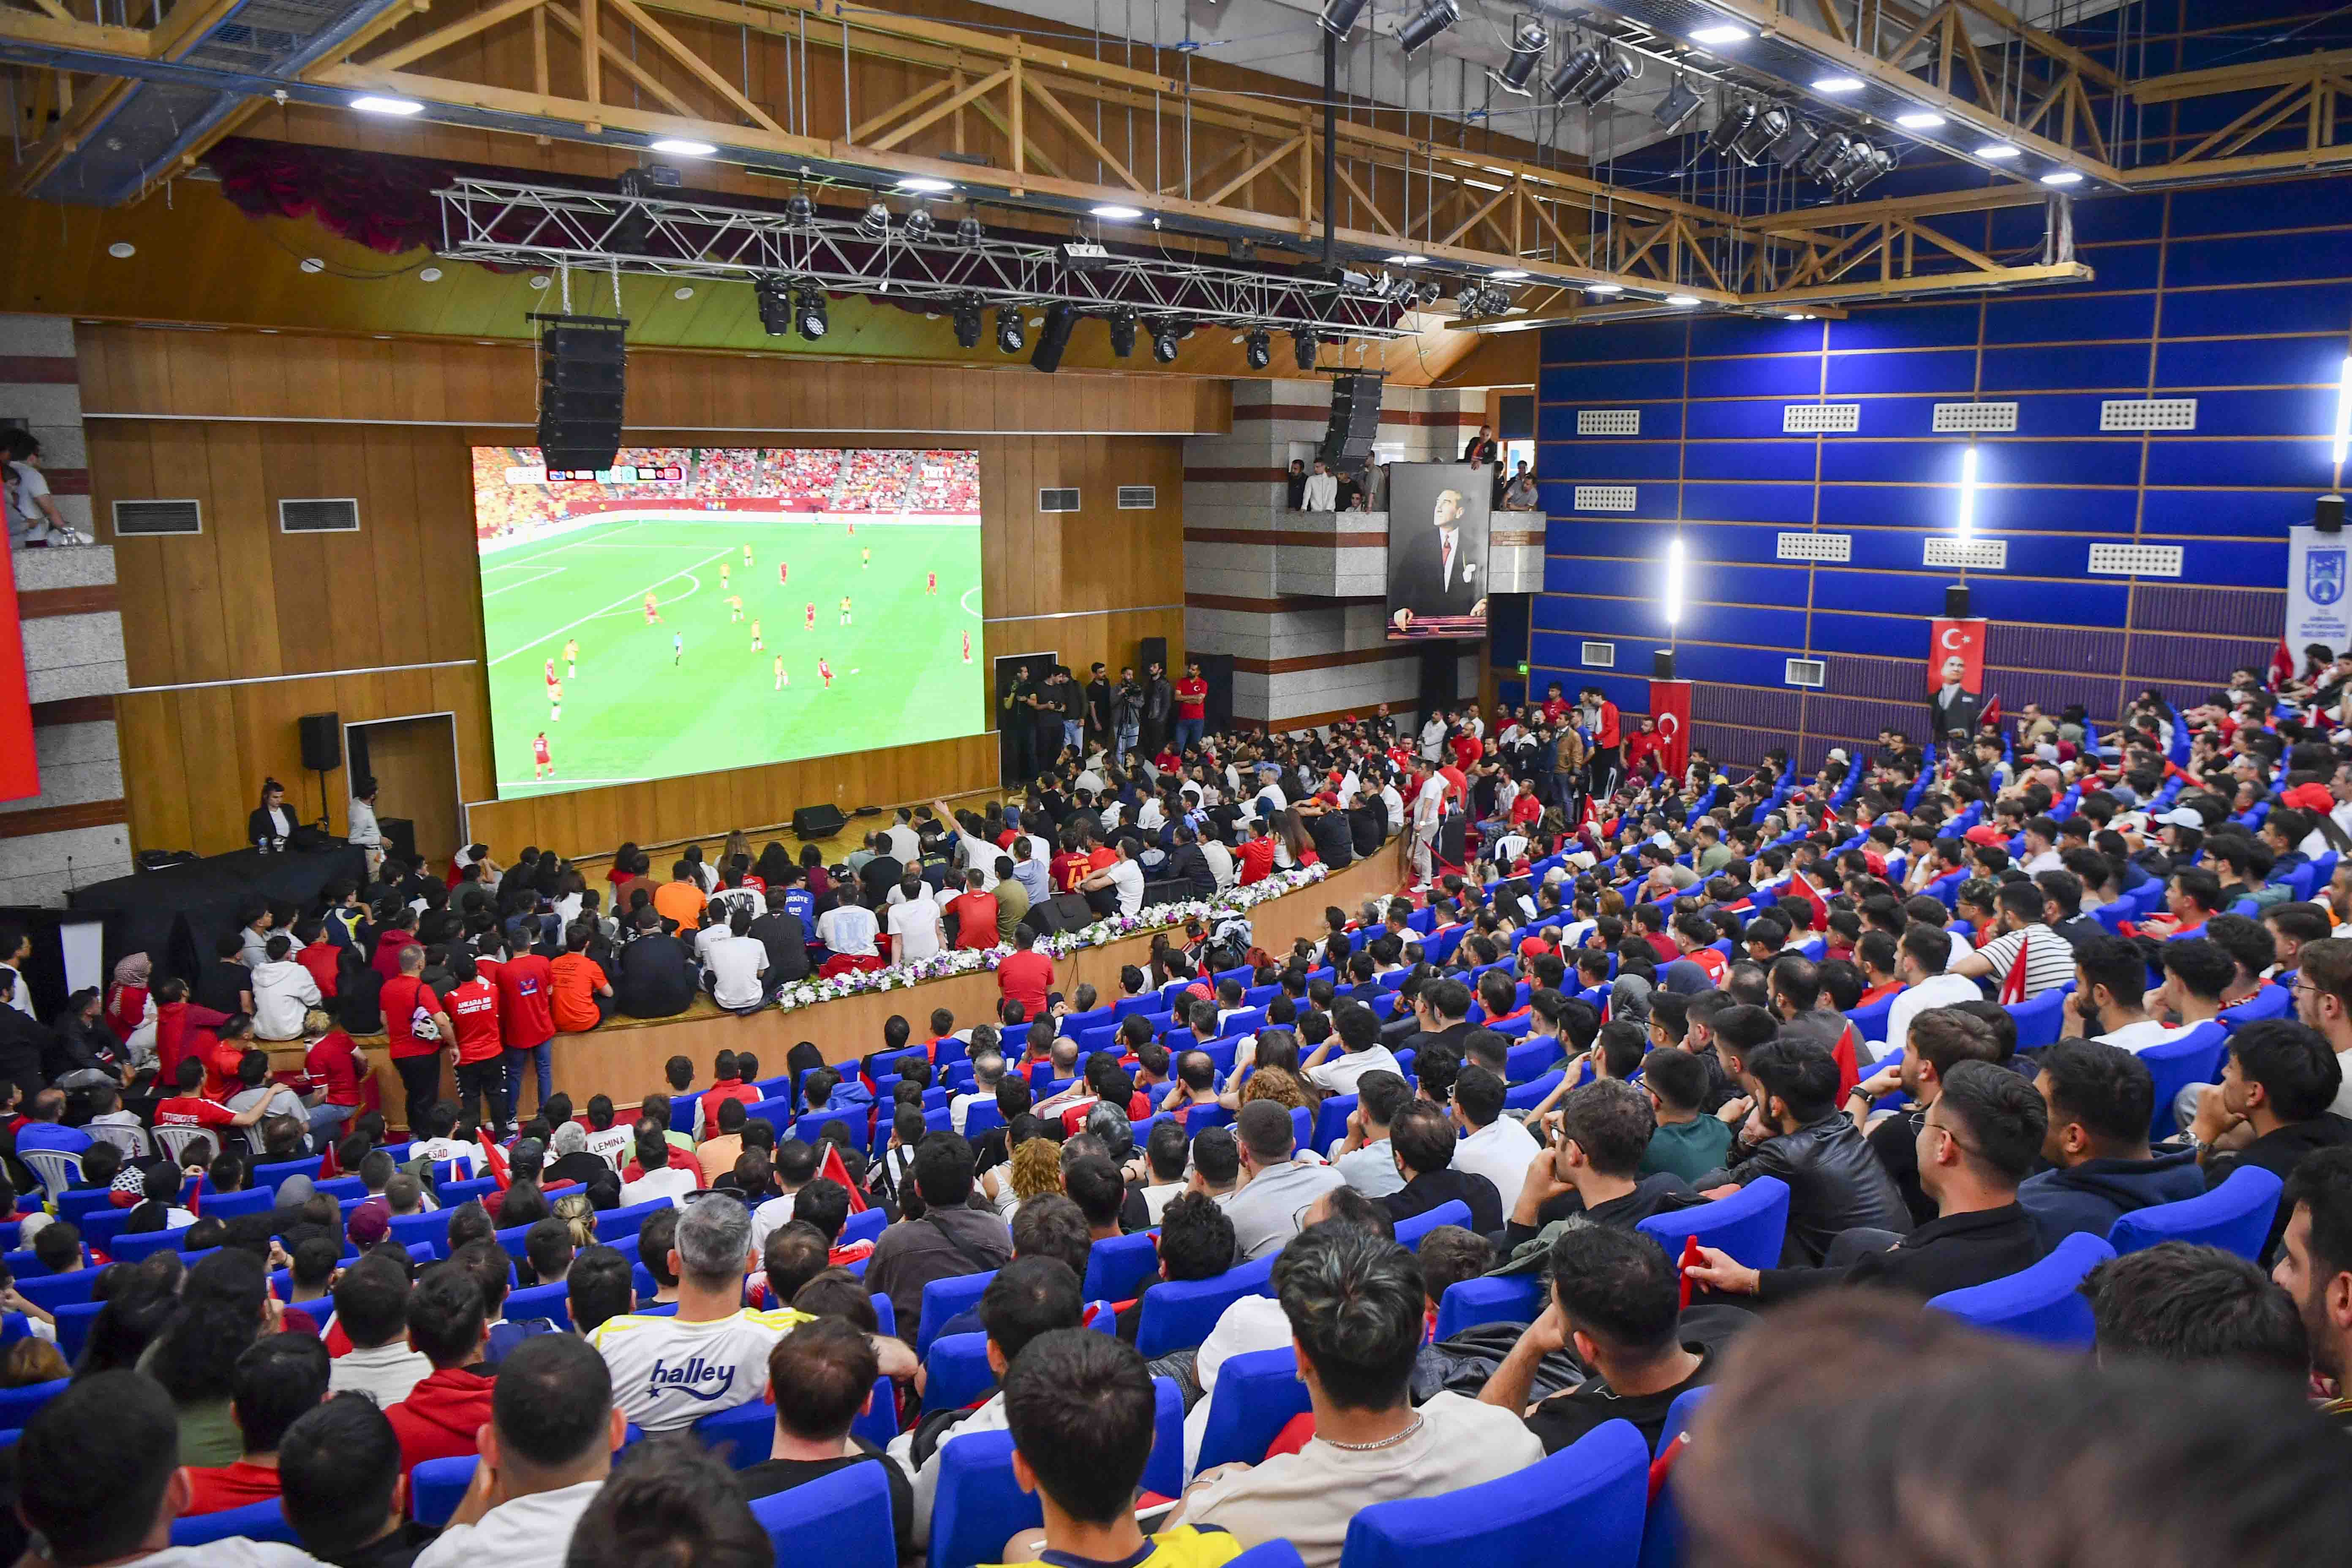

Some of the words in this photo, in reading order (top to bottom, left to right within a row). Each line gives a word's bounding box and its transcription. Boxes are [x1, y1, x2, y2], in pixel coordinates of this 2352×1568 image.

[786, 895, 808, 904] RKİYE
[593, 1136, 626, 1153] LEMINA
[649, 1358, 736, 1401] halley
